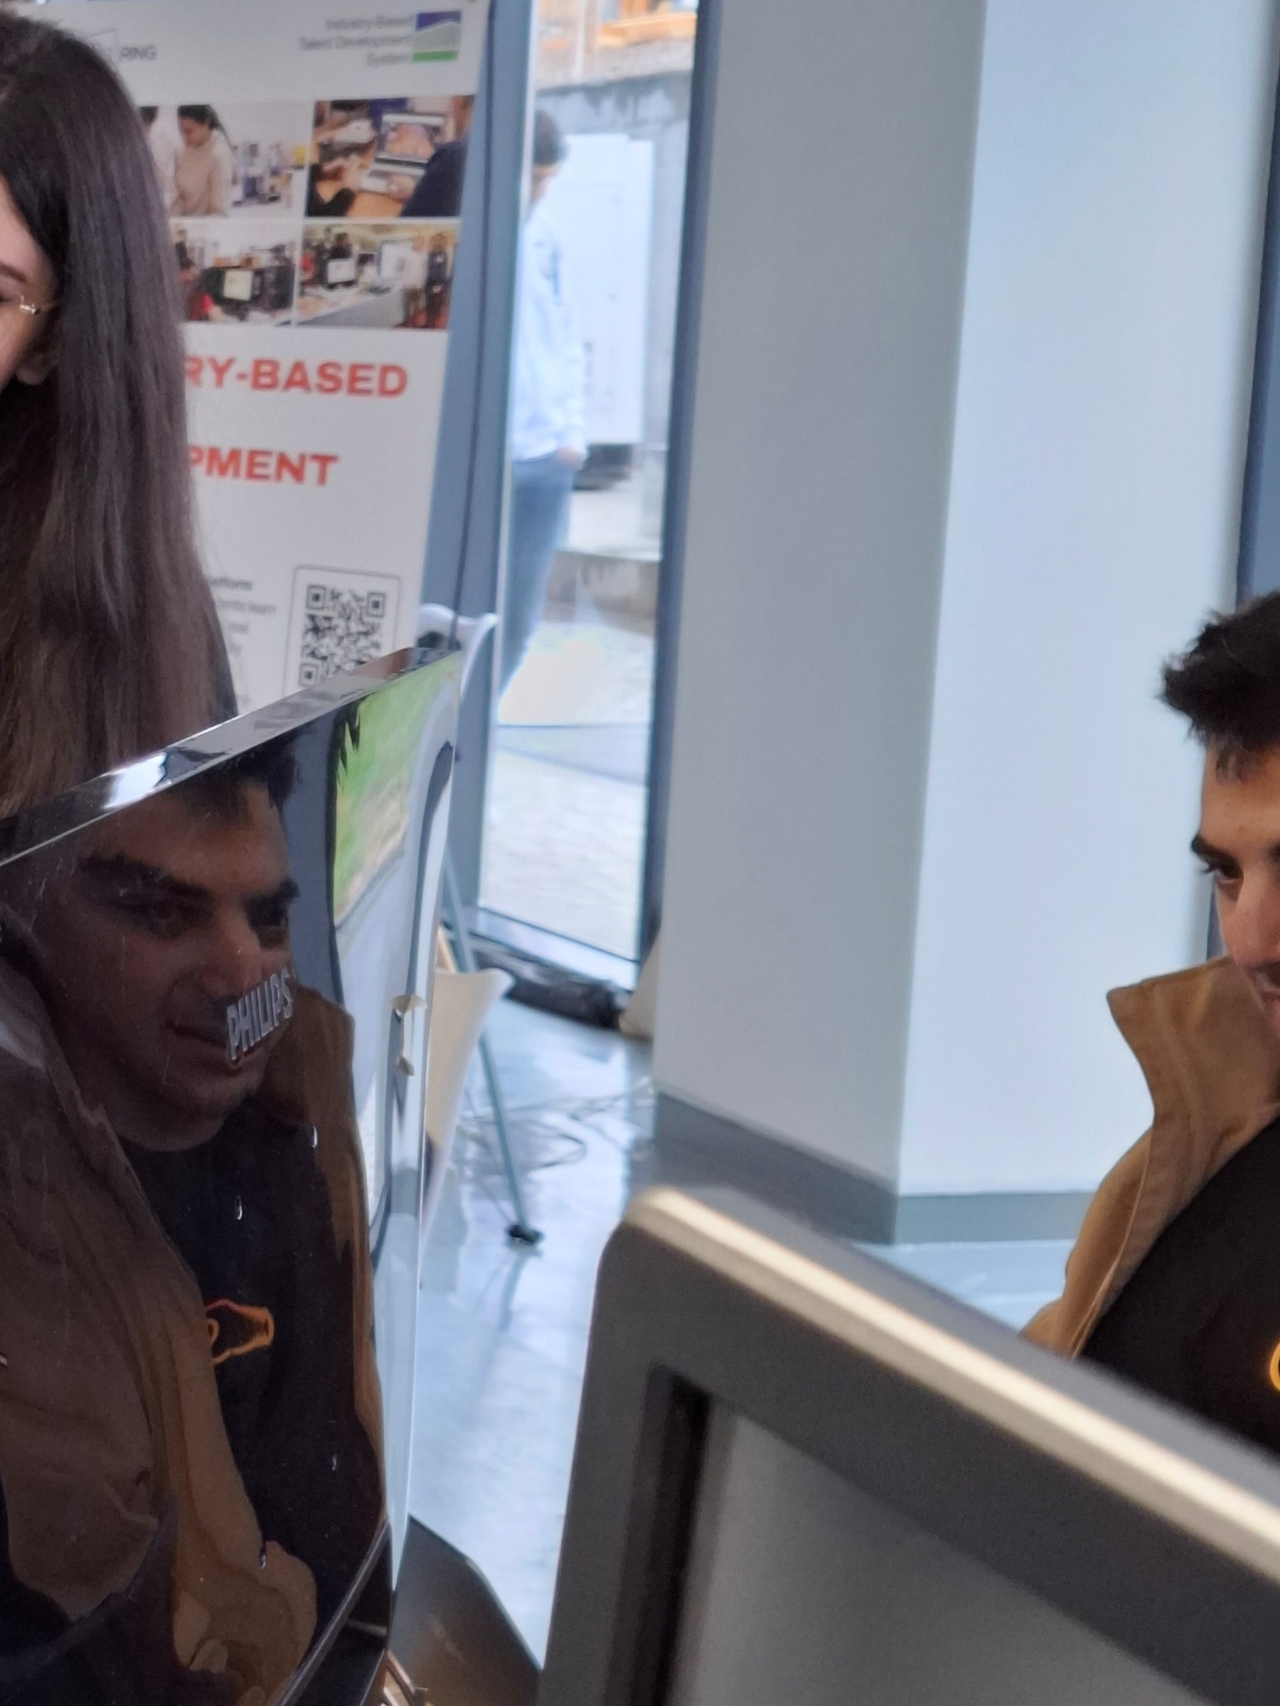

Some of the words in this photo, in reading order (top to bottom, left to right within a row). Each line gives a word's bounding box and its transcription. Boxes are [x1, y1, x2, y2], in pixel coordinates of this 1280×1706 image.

[185, 355, 408, 398] RY-BASED
[189, 446, 339, 486] PMENT
[227, 965, 294, 1061] PHILIPS
